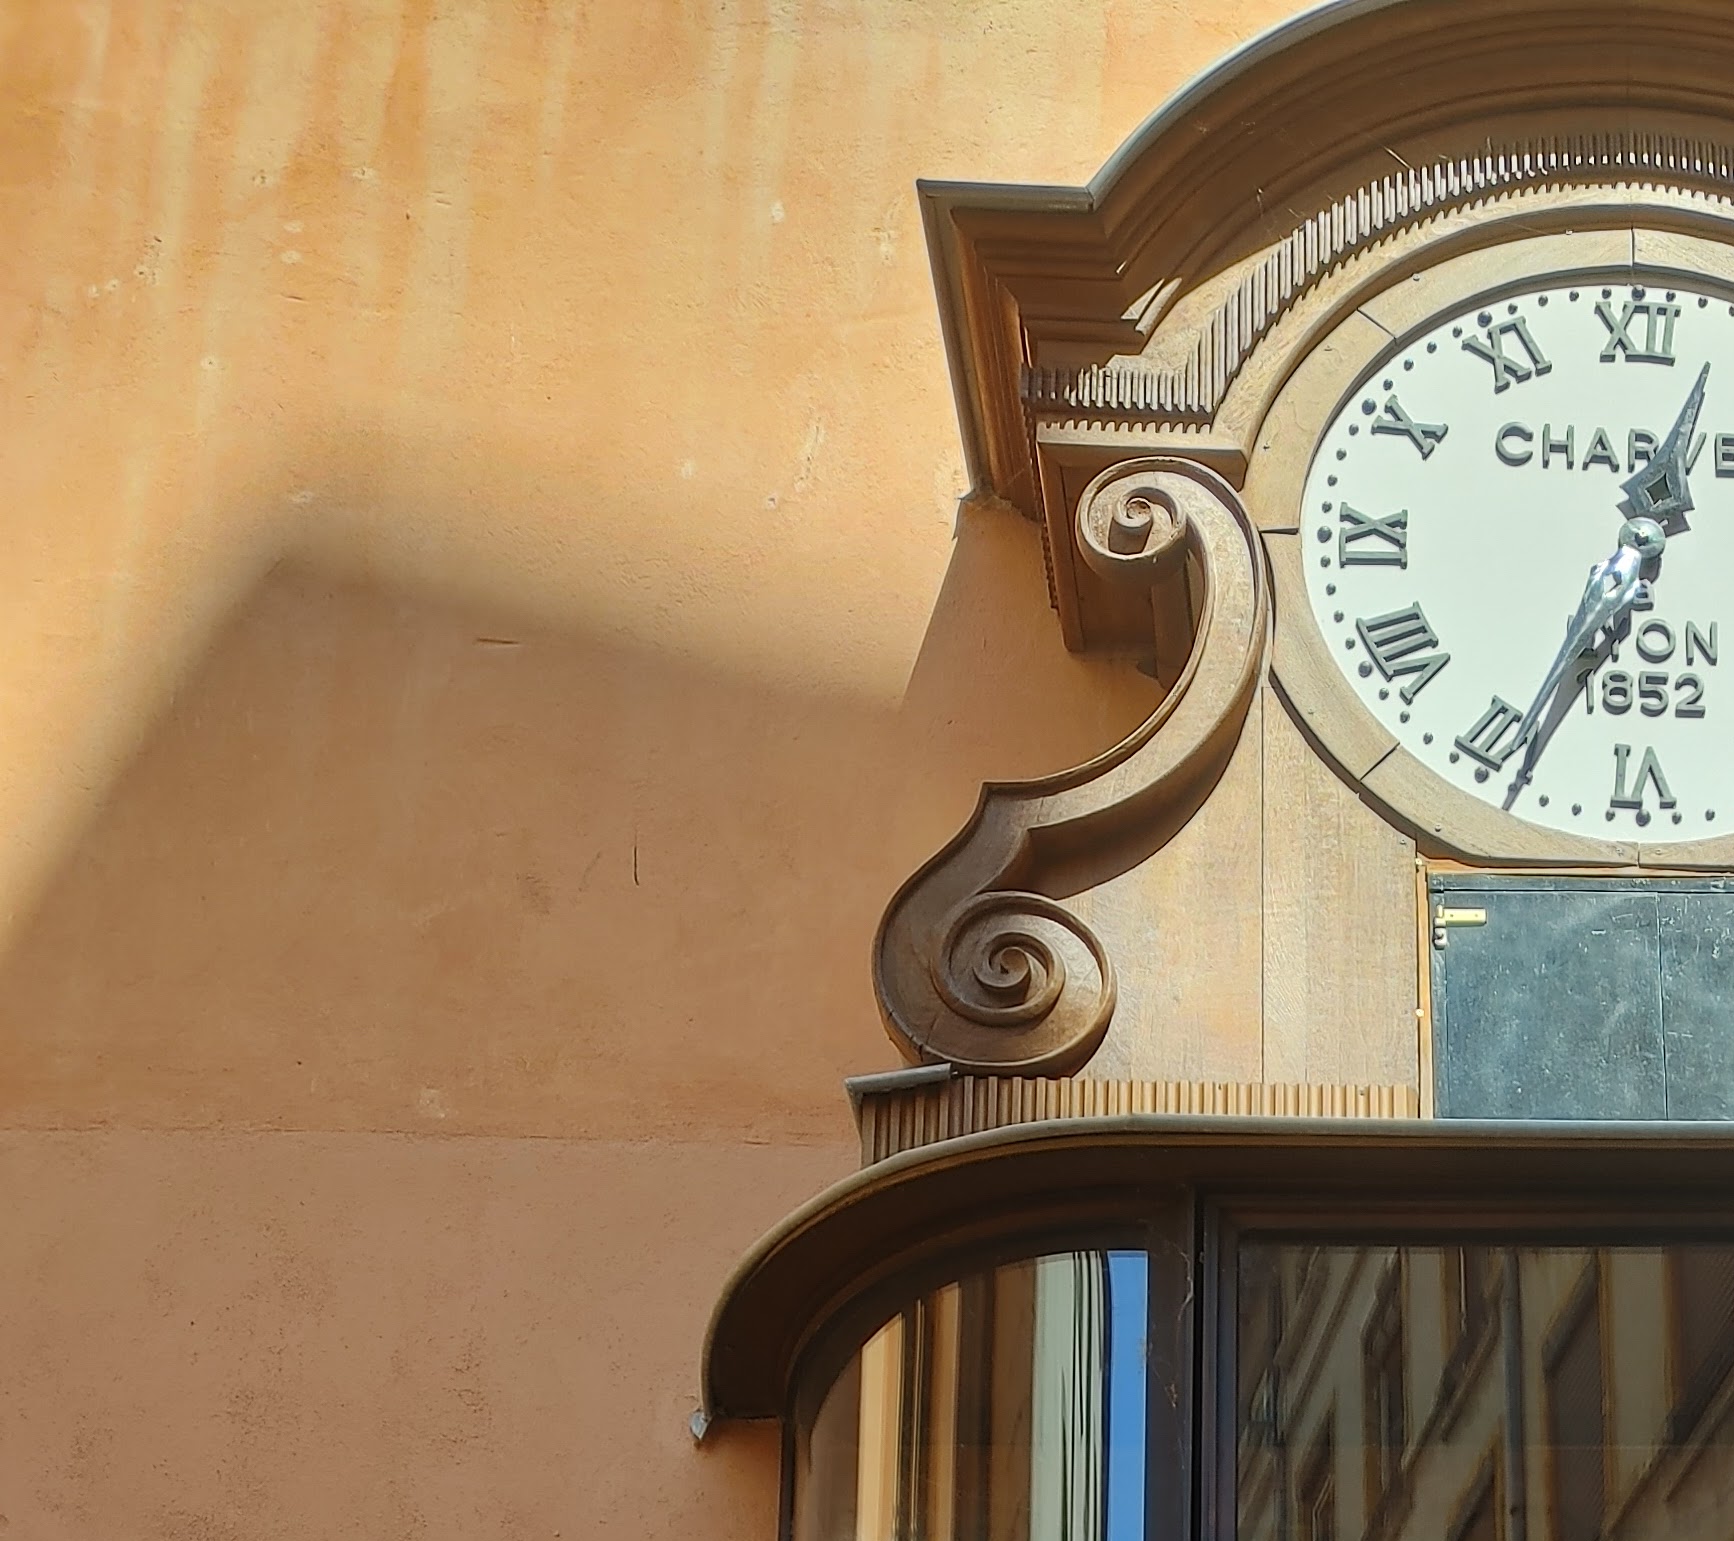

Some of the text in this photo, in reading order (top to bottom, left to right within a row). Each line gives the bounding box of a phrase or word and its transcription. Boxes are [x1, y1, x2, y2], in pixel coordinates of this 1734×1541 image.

[1462, 316, 1551, 392] XI
[1596, 300, 1681, 364] XII
[1372, 395, 1448, 458] X
[1339, 502, 1408, 569] IX
[1356, 603, 1451, 704] VIII
[1576, 668, 1706, 719] 1852
[1611, 744, 1677, 809] VI
